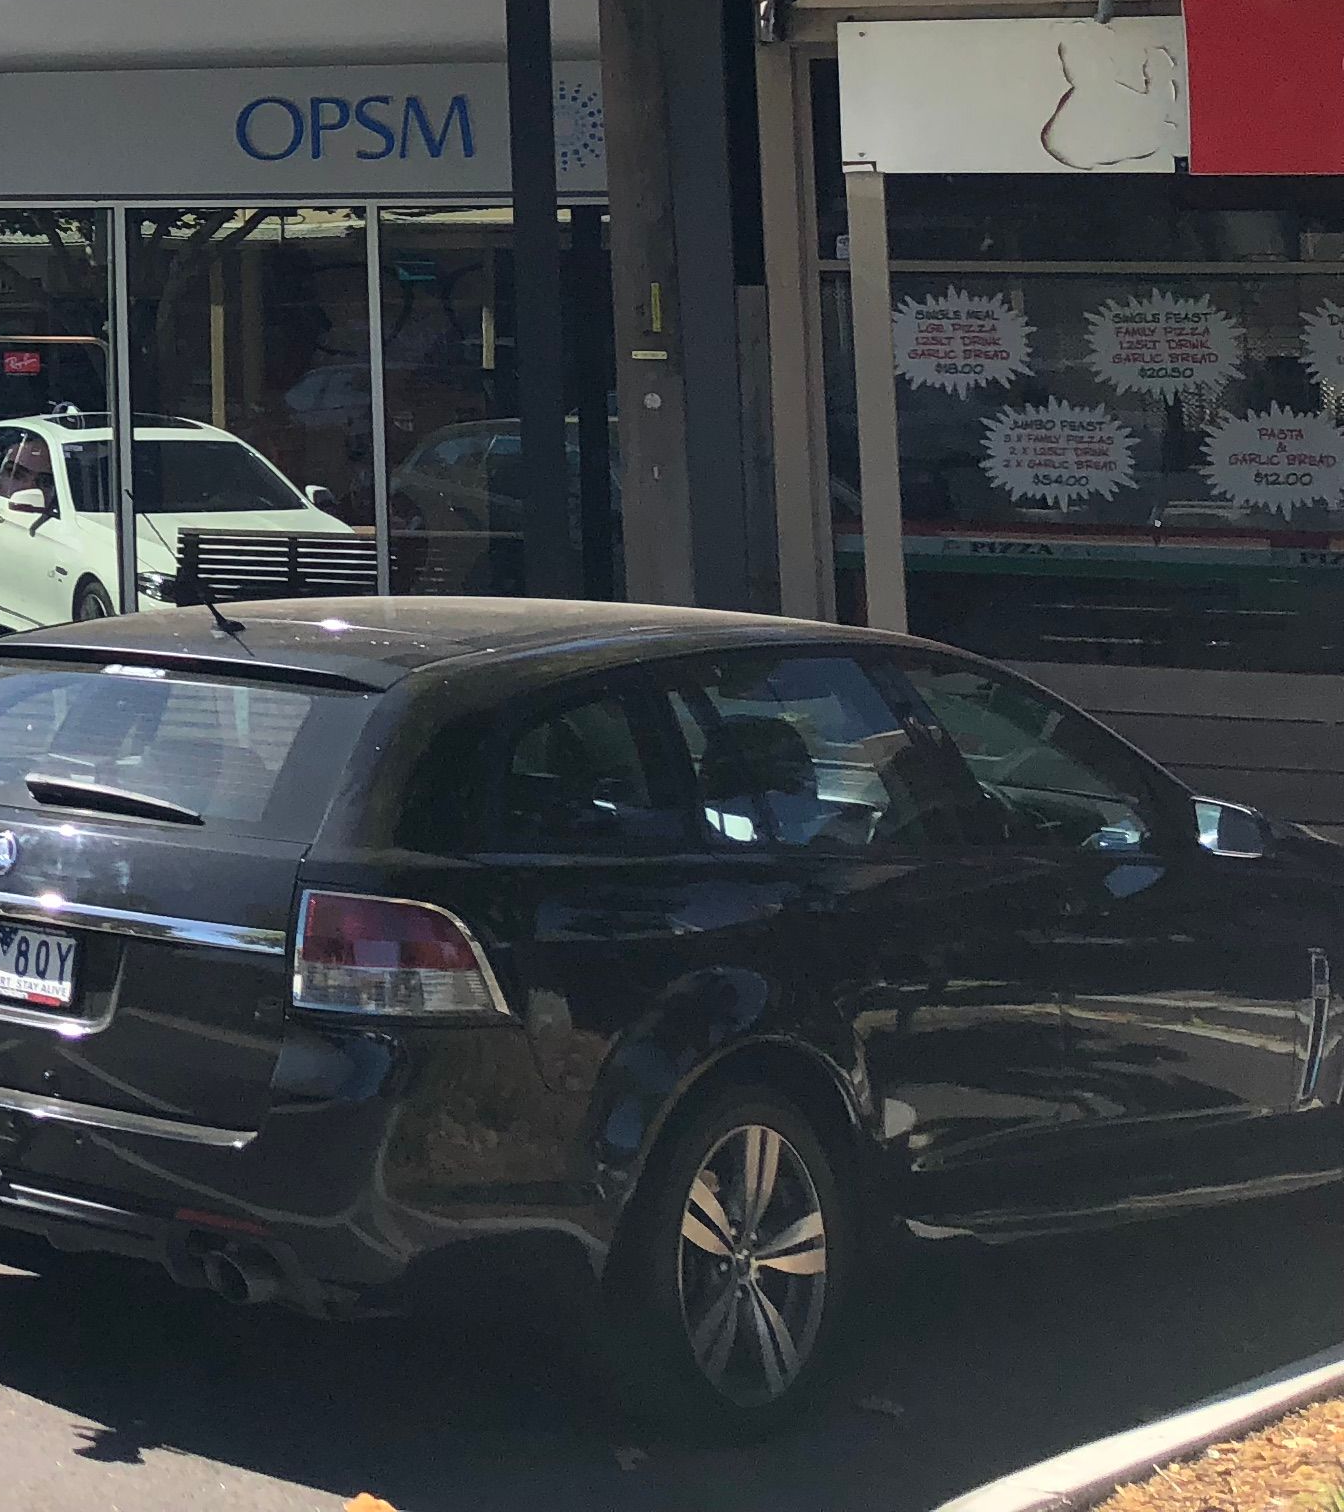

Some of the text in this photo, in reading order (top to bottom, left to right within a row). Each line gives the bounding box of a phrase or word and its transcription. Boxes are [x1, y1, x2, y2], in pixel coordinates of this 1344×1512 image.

[235, 93, 475, 162] OPSM
[1164, 312, 1212, 324] FEAST
[950, 323, 997, 334] PIZZA
[1163, 327, 1211, 338] PIZZA
[959, 335, 1002, 347] DRINK
[1165, 339, 1213, 351] DRINK
[907, 348, 1011, 361] GARLIC BREAD
[1112, 352, 1219, 365] GARLIC BREAD
[1257, 427, 1305, 441] PASTA
[1276, 441, 1288, 454] &
[1228, 452, 1337, 468] GARLIC BREAD
[1254, 469, 1313, 486] $12.00
[970, 539, 1054, 556] PIZZA
[15, 978, 40, 992] STAY
